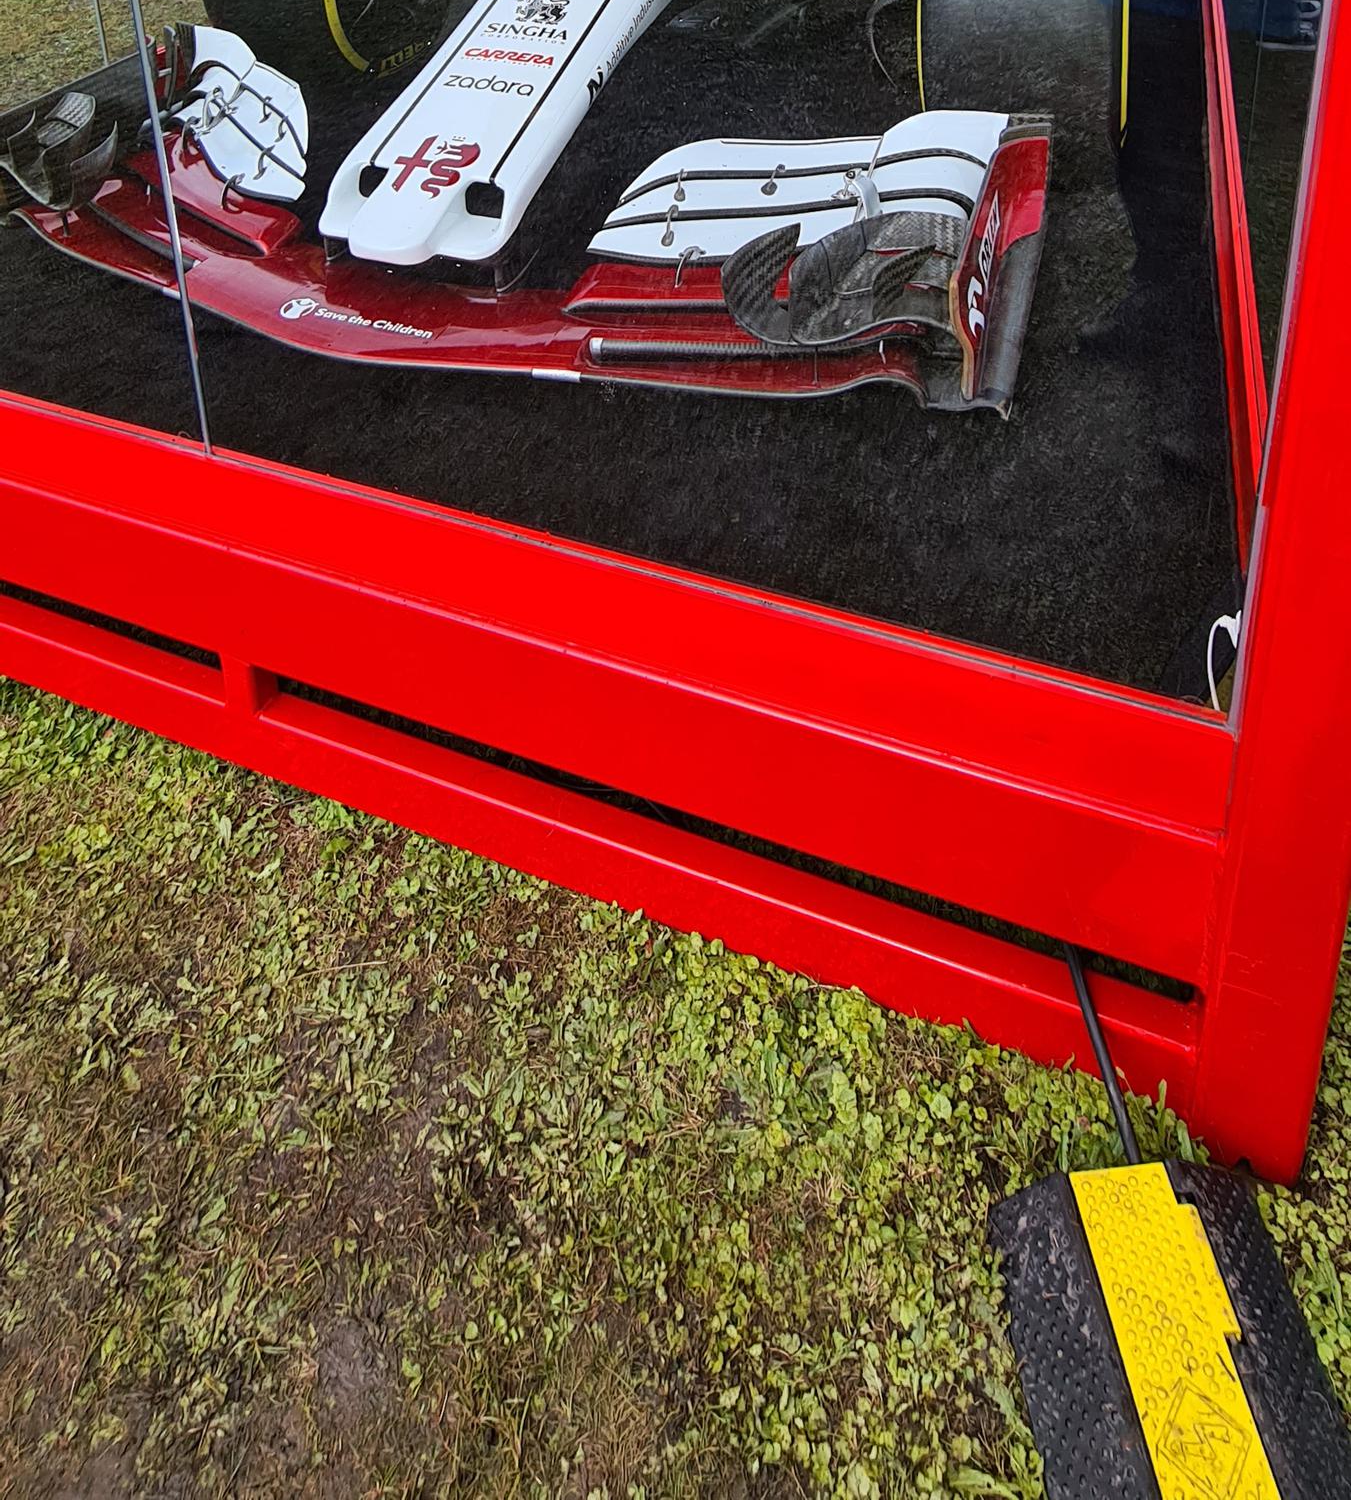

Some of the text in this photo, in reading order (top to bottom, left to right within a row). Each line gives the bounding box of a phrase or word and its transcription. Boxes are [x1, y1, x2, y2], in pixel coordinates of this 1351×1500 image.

[484, 23, 568, 40] SINGHA
[464, 48, 555, 66] CARRERA
[606, 26, 634, 73] Additive
[443, 74, 535, 97] zadara
[314, 308, 433, 340] Save the Children
